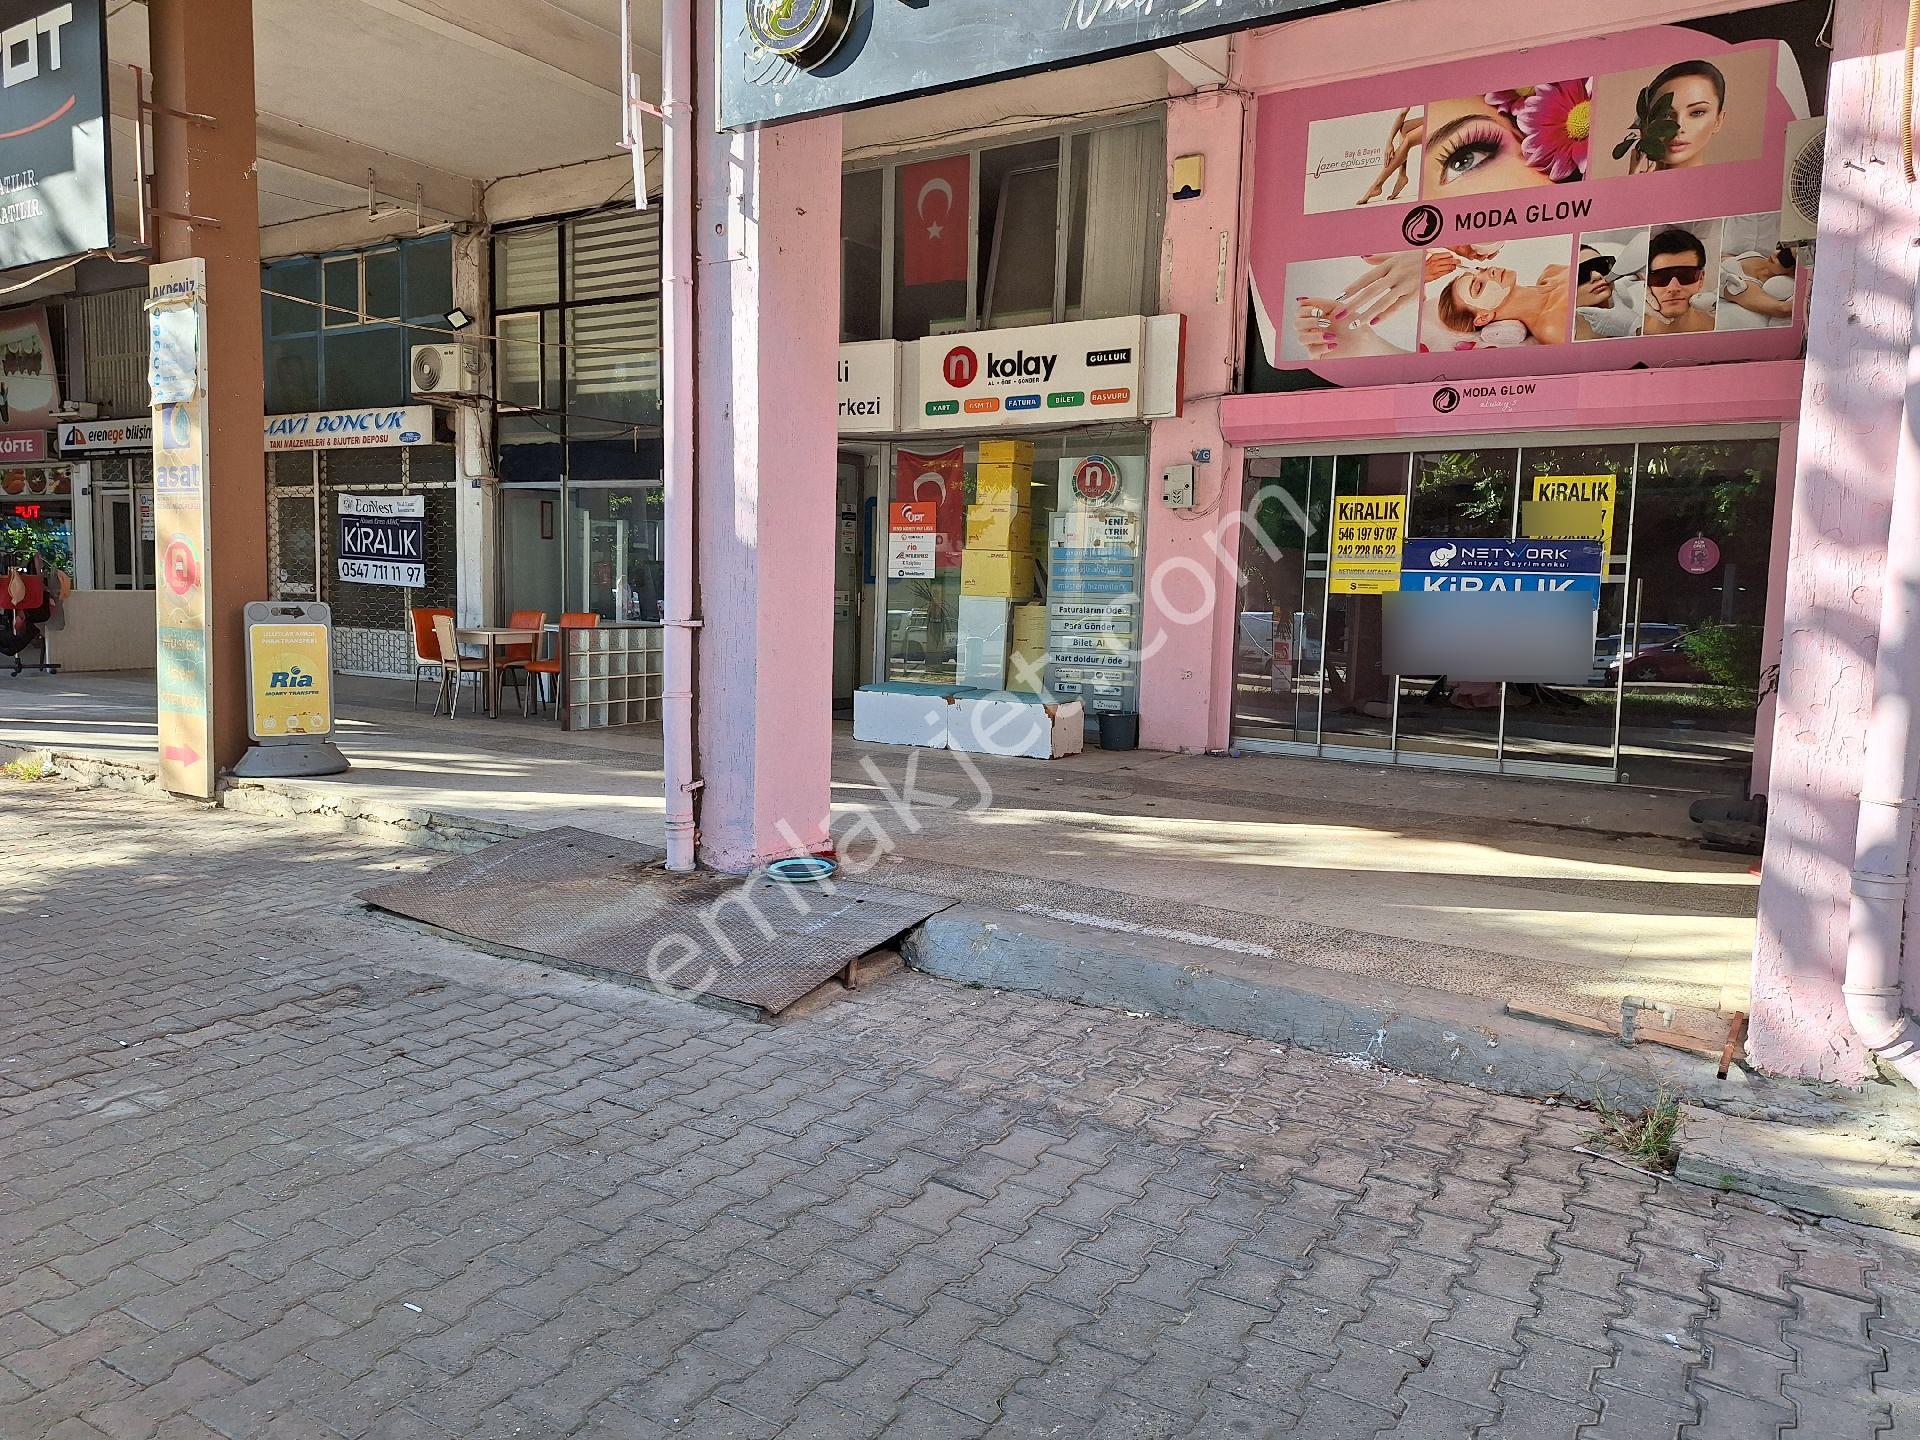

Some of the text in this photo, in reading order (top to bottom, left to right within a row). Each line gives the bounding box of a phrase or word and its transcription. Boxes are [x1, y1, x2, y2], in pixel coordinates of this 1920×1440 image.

[0, 2, 73, 88] OT
[0, 199, 42, 224] ATILIR.
[1455, 199, 1592, 231] MODA GLOW
[1089, 352, 1127, 362] GÜLLÜK
[988, 350, 1057, 382] kolay
[1092, 392, 1129, 401] BAŞVURU
[1463, 384, 1536, 398] MODA GLOW
[1008, 399, 1036, 407] FATURA
[1056, 395, 1074, 404] BİLET
[315, 411, 407, 432] BONCUK
[362, 434, 389, 444] DEPOSU
[157, 464, 199, 487] asat
[1338, 501, 1401, 521] KiRALIK
[344, 522, 417, 556] KİRALIK
[1338, 527, 1397, 541] 546 197 97 07
[1337, 544, 1396, 558] 242 228 06 22
[1462, 544, 1569, 560] NETWORK
[1460, 560, 1570, 568] Antalya Gayrimenkul
[342, 561, 421, 582] 0547 711 11 97
[1064, 621, 1115, 631] Para Gönder
[1073, 639, 1092, 647] Bilet
[1055, 654, 1072, 662] Kart
[1073, 654, 1100, 664] doldur
[1107, 656, 1123, 665] öde
[270, 665, 313, 688] Ria
